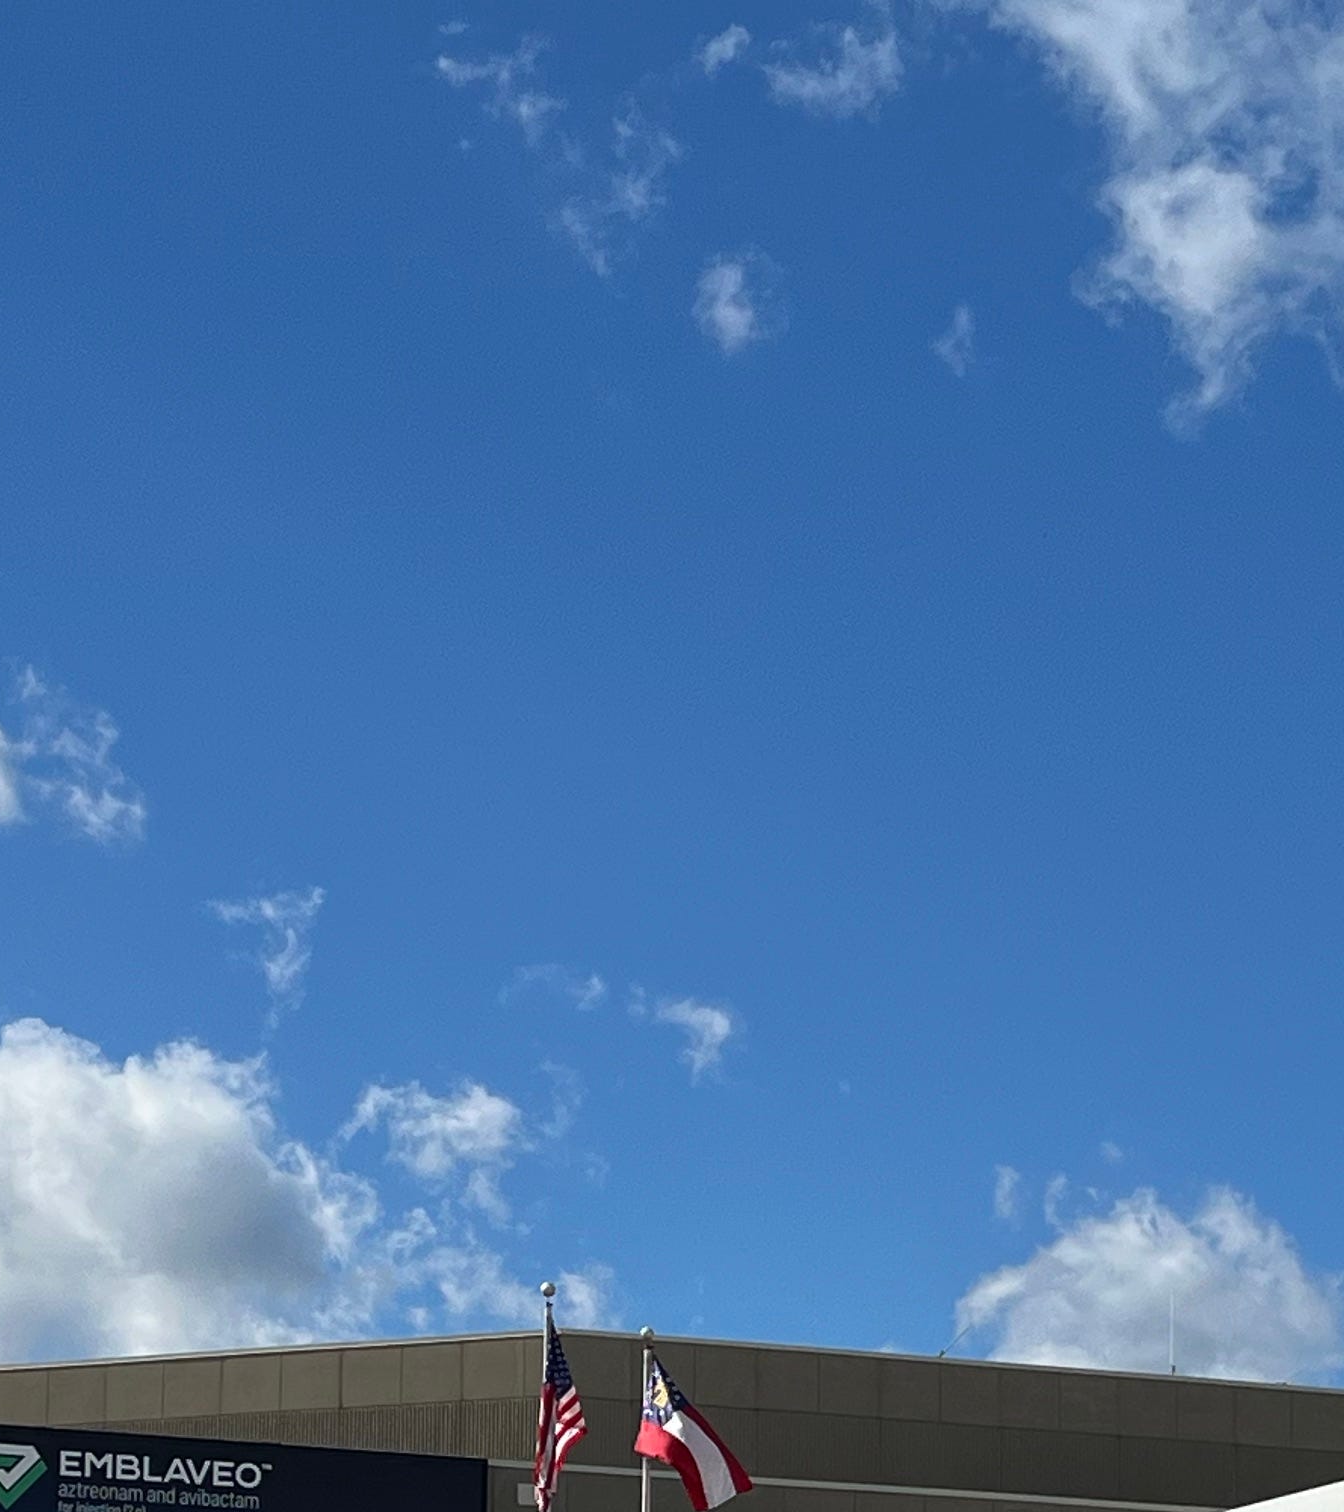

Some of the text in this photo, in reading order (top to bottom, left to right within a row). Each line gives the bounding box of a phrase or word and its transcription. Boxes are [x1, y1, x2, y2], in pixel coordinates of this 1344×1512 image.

[57, 1482, 261, 1510] aztreonam and avibactam
[57, 1500, 73, 1512] for
